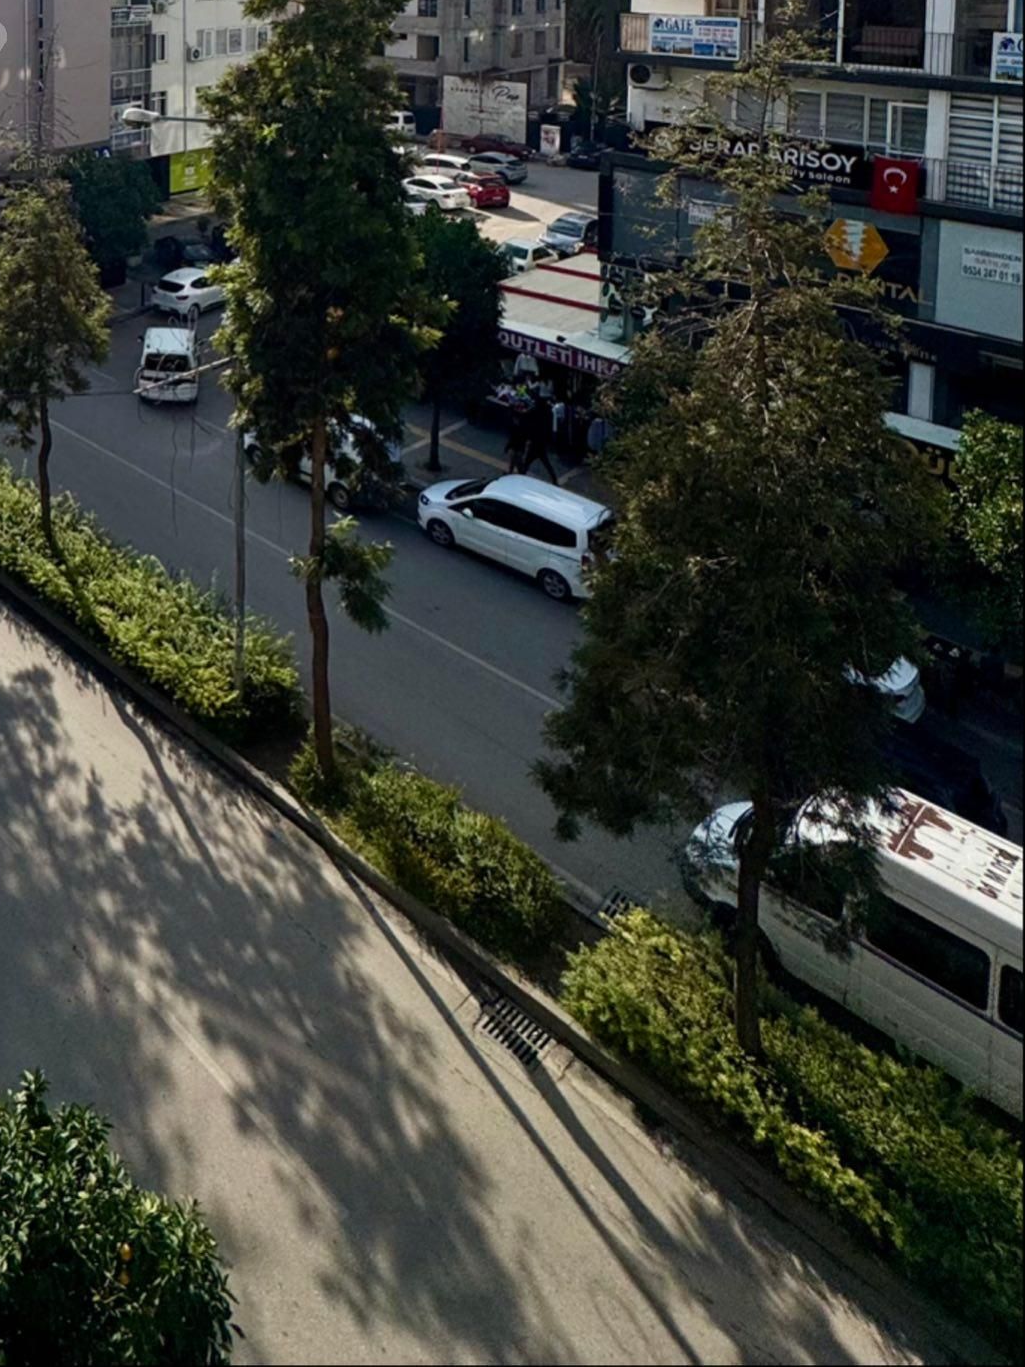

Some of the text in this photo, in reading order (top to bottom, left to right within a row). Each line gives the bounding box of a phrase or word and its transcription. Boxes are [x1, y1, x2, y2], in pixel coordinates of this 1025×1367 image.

[665, 18, 694, 31] GATE
[498, 331, 622, 377] OUTLET İHRA
